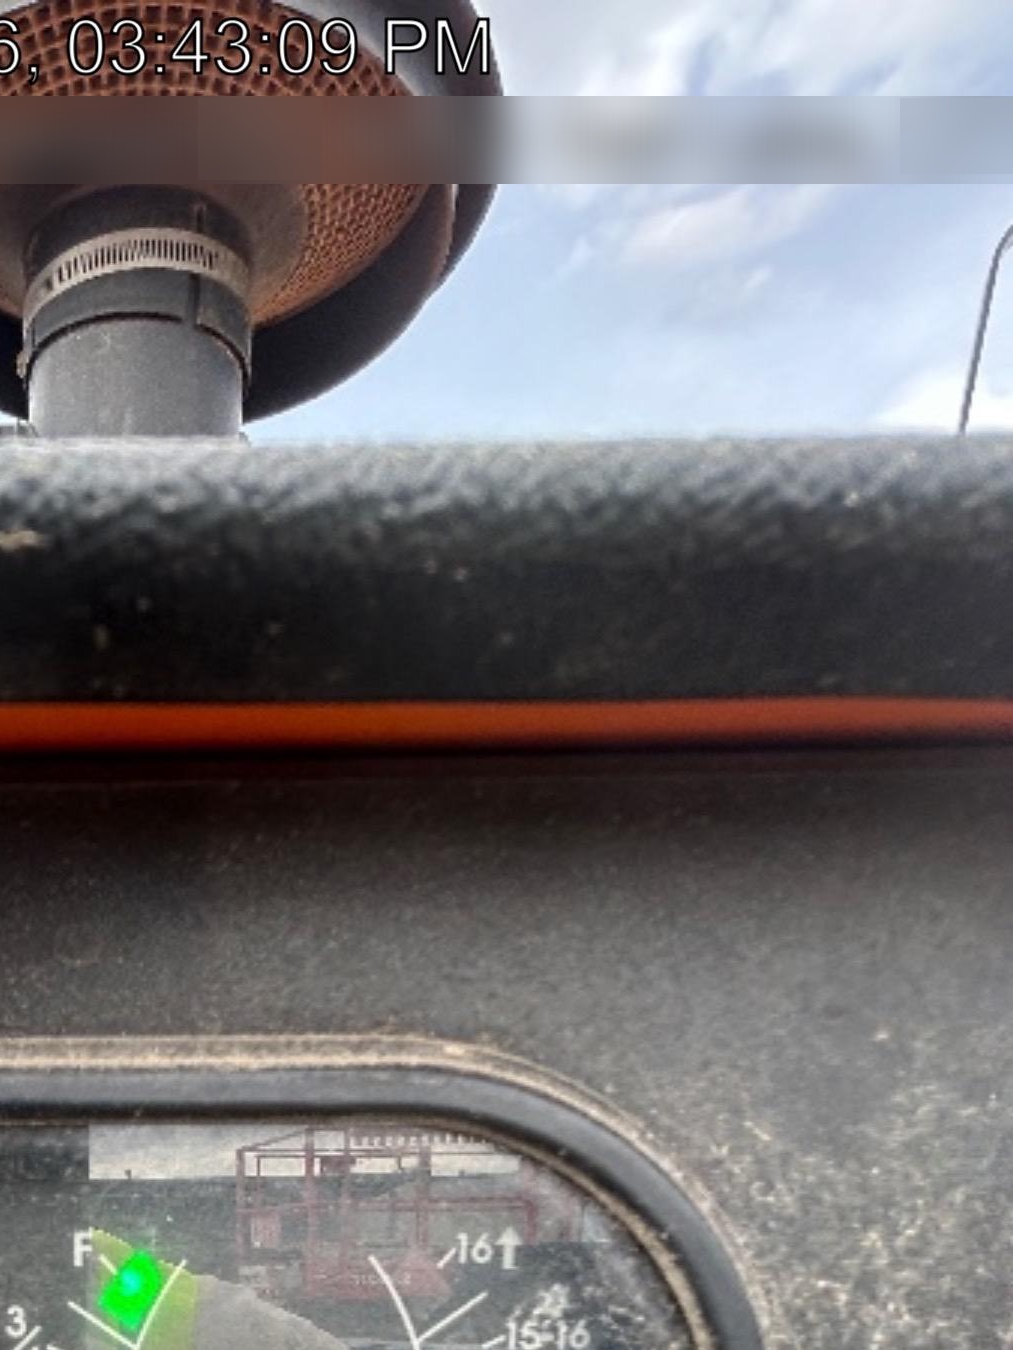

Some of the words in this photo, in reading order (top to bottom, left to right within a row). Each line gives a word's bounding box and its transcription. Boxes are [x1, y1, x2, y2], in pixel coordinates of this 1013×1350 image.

[73, 1234, 93, 1268] F
[456, 1233, 492, 1264] 16
[506, 1319, 591, 1350] 15-16
